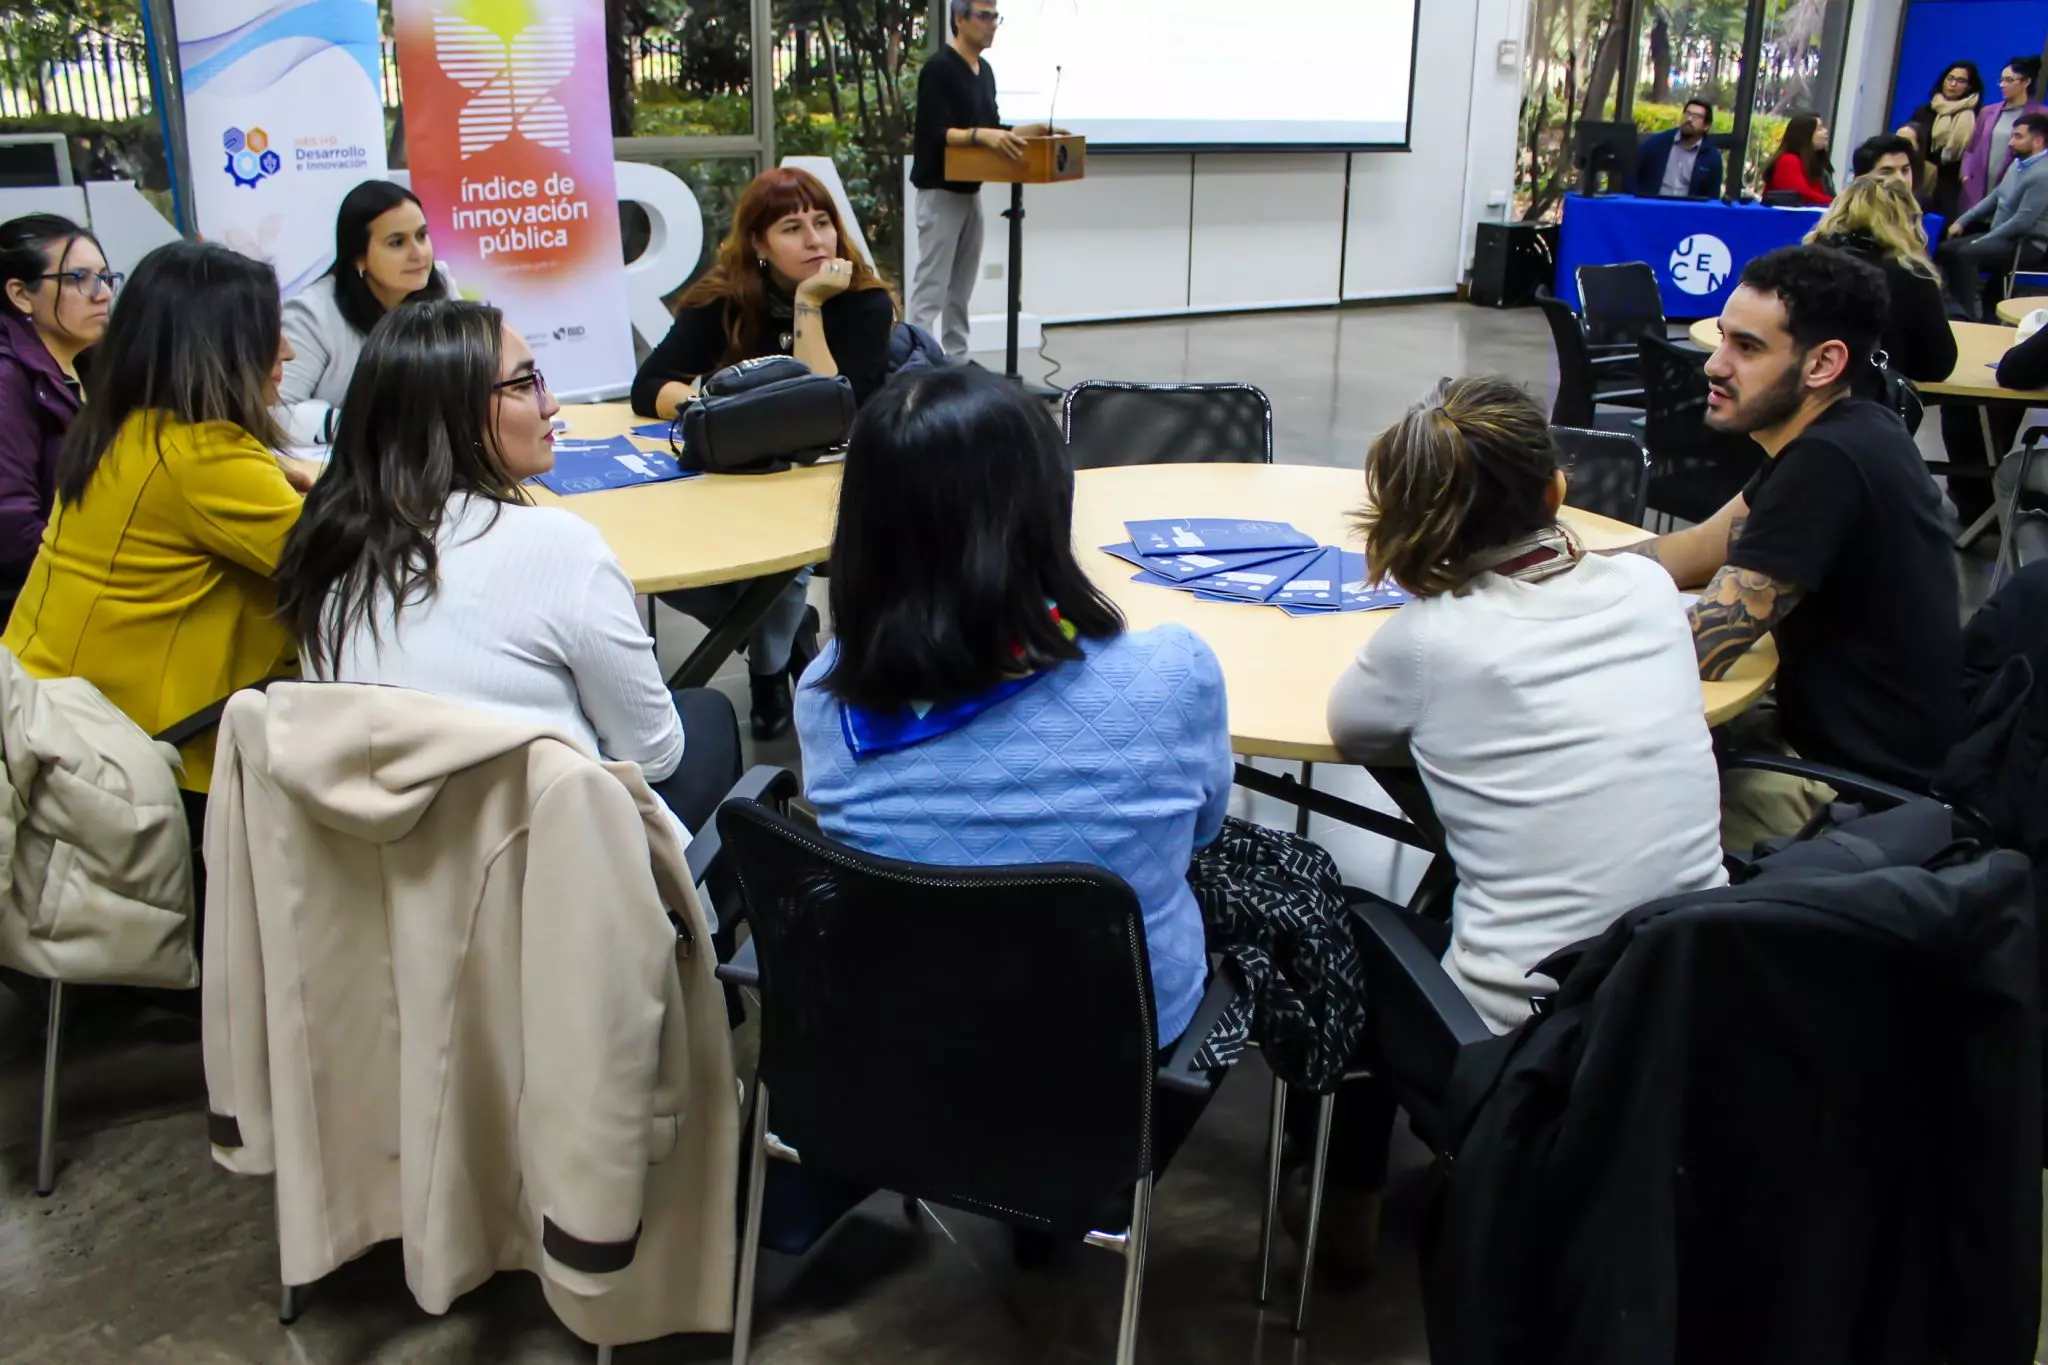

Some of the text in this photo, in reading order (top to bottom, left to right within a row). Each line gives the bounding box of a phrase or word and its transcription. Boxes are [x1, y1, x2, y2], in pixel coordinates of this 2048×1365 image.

[295, 145, 366, 160] Desarrollo
[296, 162, 303, 171] e
[461, 171, 575, 203] índice de
[452, 197, 588, 231] innovación
[479, 225, 568, 259] pública
